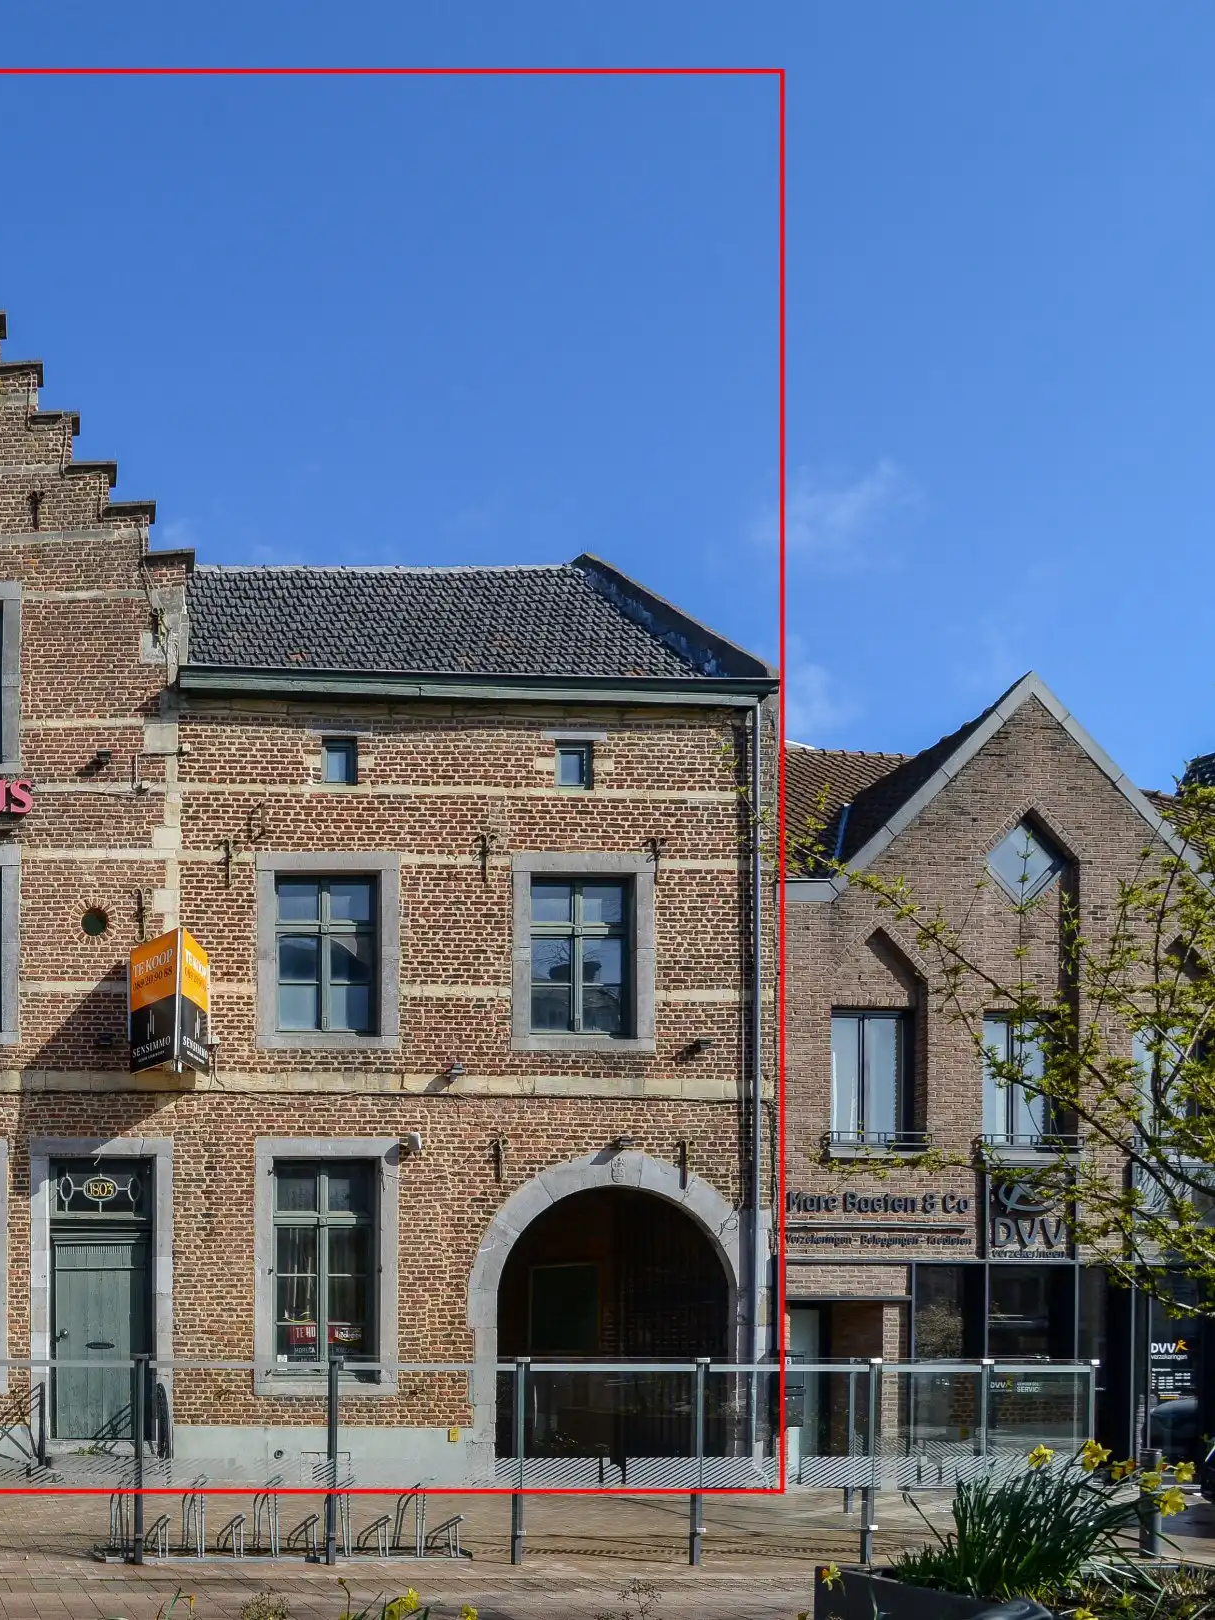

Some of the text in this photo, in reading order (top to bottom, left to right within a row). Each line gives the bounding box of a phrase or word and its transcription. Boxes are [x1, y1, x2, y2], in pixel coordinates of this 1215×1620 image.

[134, 948, 173, 977] TE KOOP
[145, 975, 153, 985] 20
[154, 971, 163, 981] 90
[132, 1036, 171, 1058] SENSIMMO
[87, 1182, 114, 1197] 1803
[923, 1192, 936, 1214] &
[943, 1192, 970, 1214] Co
[994, 1216, 1066, 1247] DVV
[296, 1326, 316, 1338] TE HU
[1150, 1343, 1176, 1354] DVV
